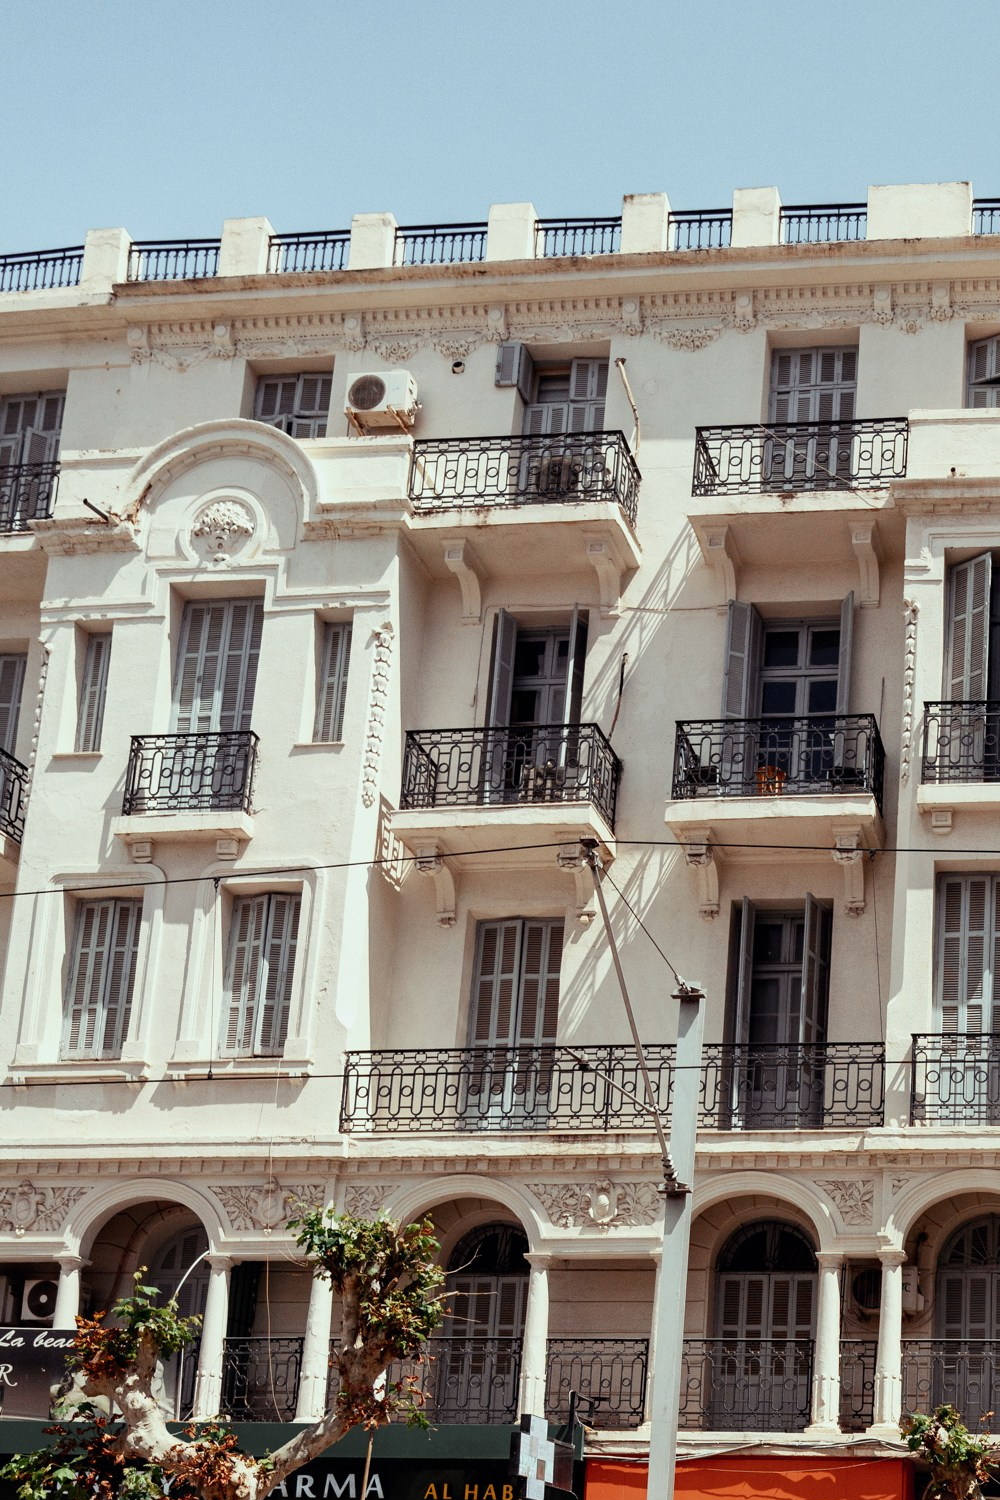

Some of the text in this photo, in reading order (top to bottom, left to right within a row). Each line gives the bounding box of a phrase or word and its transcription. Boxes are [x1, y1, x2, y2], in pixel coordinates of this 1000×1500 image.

[0, 1330, 25, 1348] La
[267, 1473, 523, 1500] ARMA AL HAB
